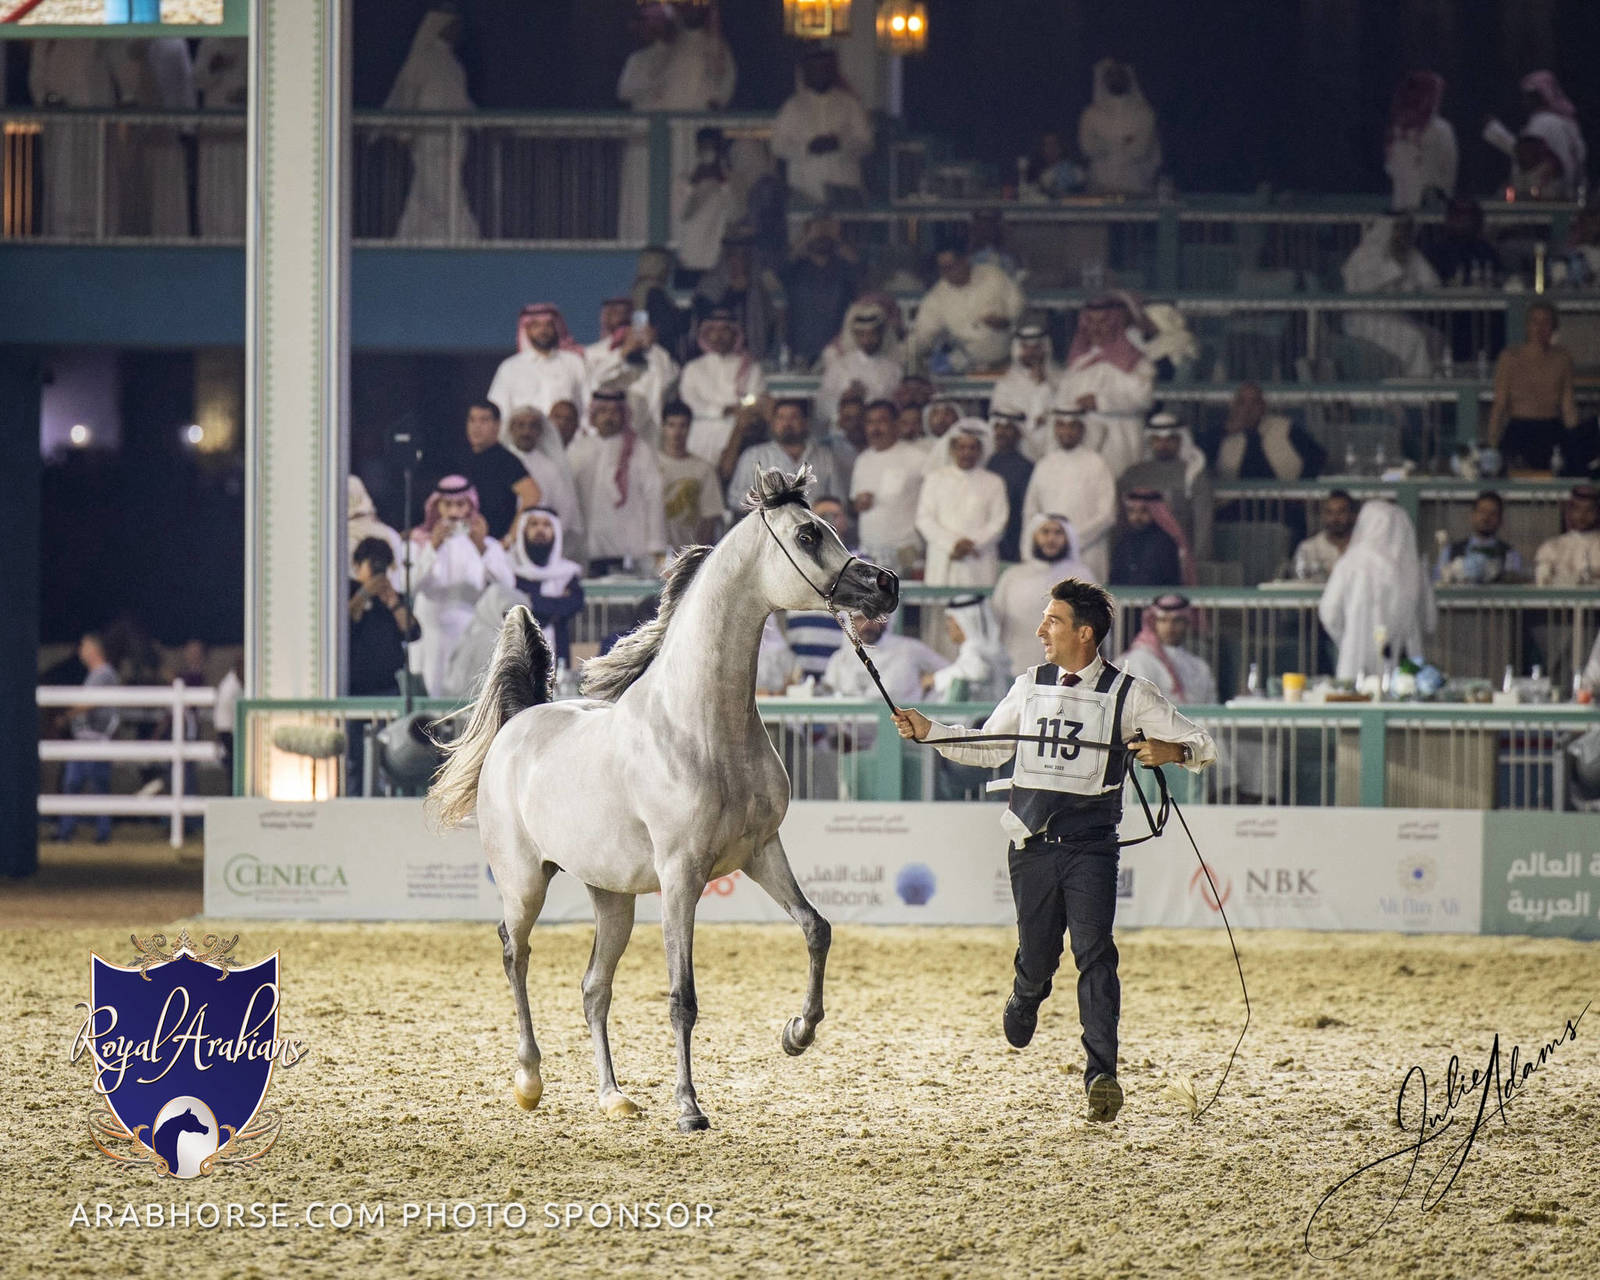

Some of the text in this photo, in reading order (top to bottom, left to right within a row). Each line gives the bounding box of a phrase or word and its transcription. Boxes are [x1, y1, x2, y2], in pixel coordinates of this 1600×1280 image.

[1036, 717, 1084, 761] 113
[233, 862, 350, 887] CENECA
[1245, 868, 1319, 894] NBK
[1506, 851, 1582, 884] العالم
[1507, 890, 1591, 923] العربية
